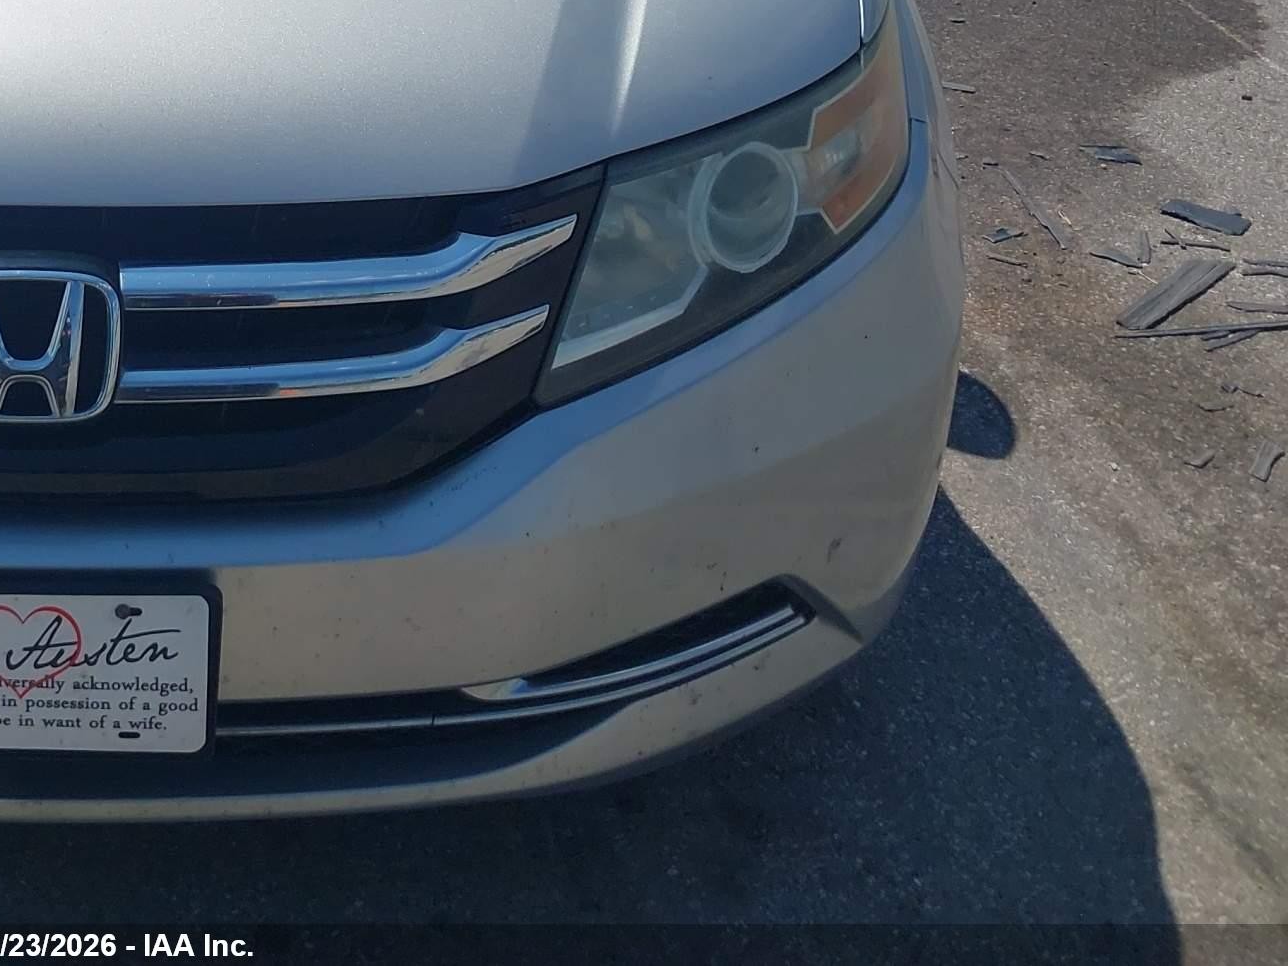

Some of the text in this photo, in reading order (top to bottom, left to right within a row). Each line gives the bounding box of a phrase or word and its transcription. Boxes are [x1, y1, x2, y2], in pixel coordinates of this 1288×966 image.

[6, 615, 181, 670] Austen
[73, 675, 194, 697] acknowledged,
[1, 694, 17, 707] in
[25, 697, 111, 712] possession
[118, 697, 138, 710] of
[142, 702, 151, 711] a
[158, 697, 198, 716] good
[18, 714, 34, 727] in
[41, 717, 81, 728] want
[89, 715, 107, 729] of
[112, 720, 121, 729] a
[128, 716, 167, 731] wife.
